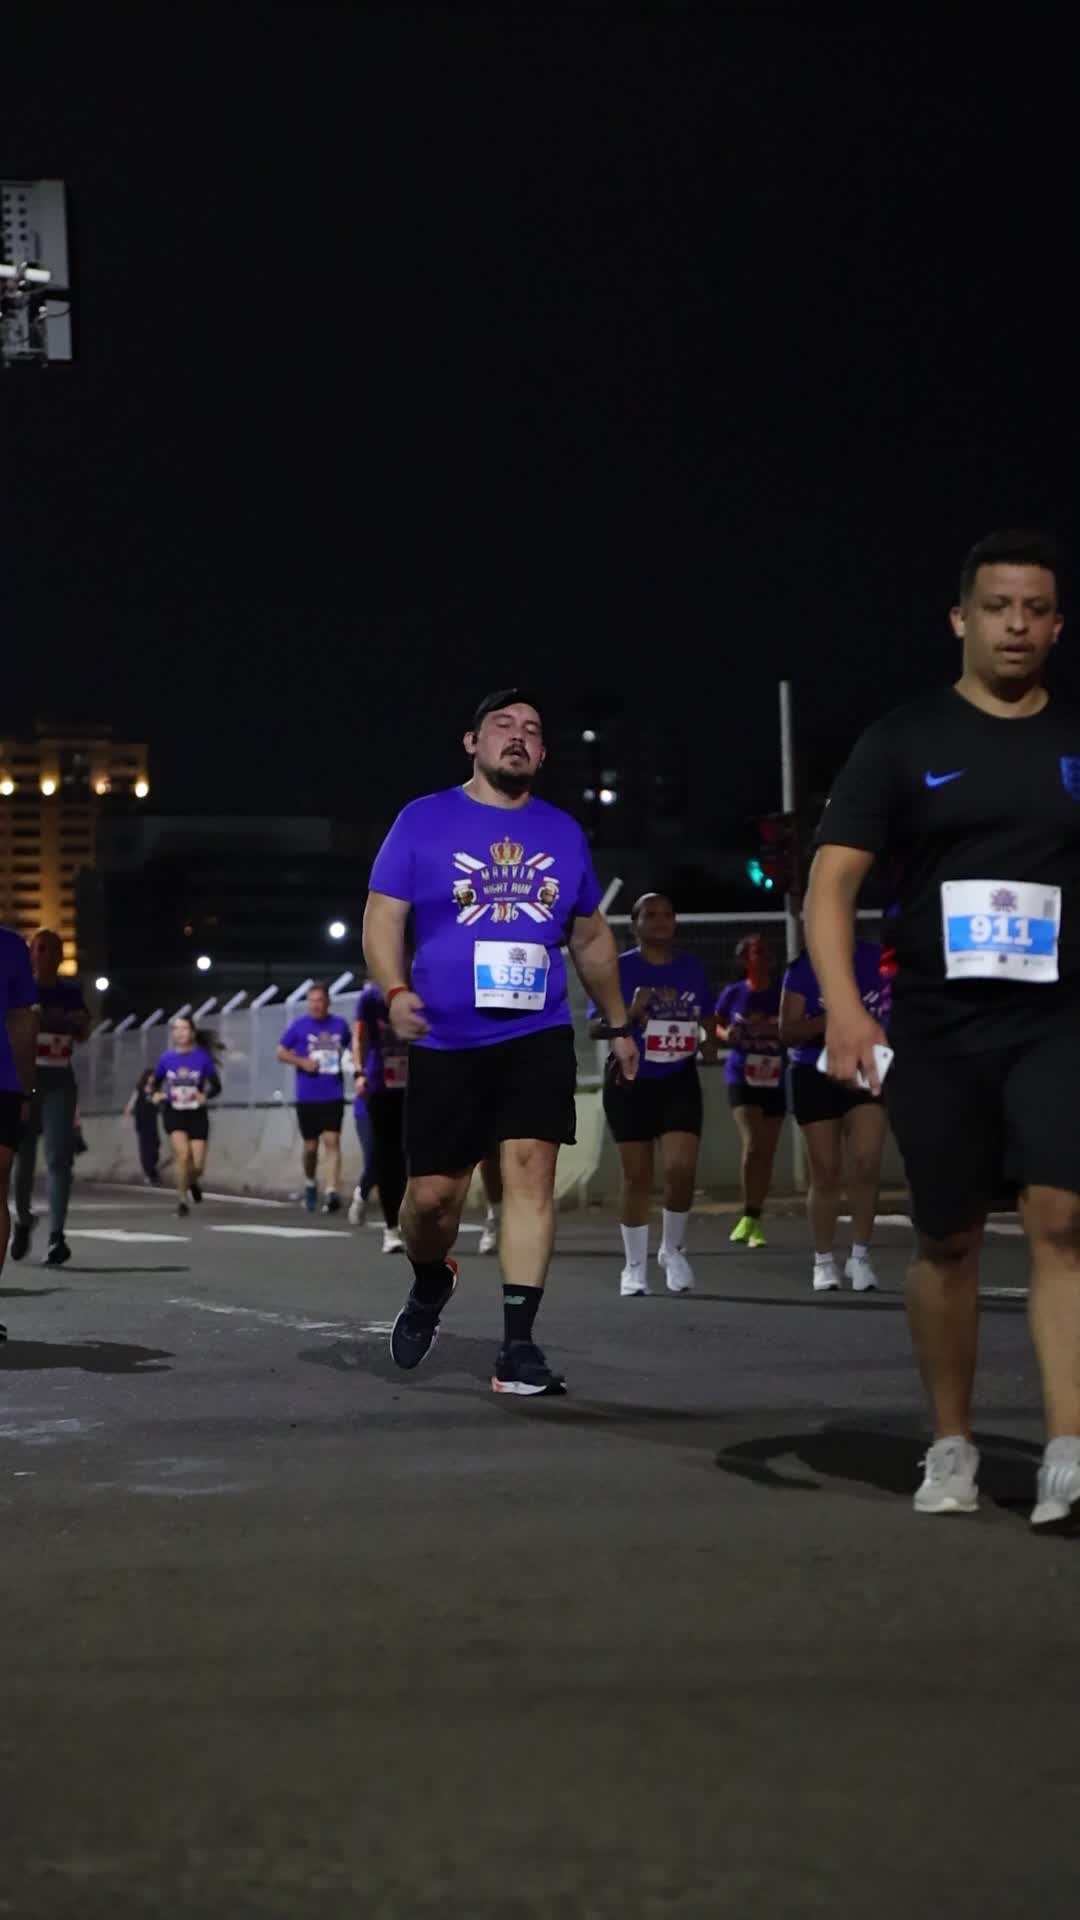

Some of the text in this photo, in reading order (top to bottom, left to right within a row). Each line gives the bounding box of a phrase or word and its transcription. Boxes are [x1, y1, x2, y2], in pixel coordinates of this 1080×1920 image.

[481, 866, 536, 880] MARVIN
[483, 882, 532, 895] NIGHT RUN
[970, 915, 1033, 945] 911
[496, 966, 536, 986] 655
[657, 1035, 686, 1049] 144
